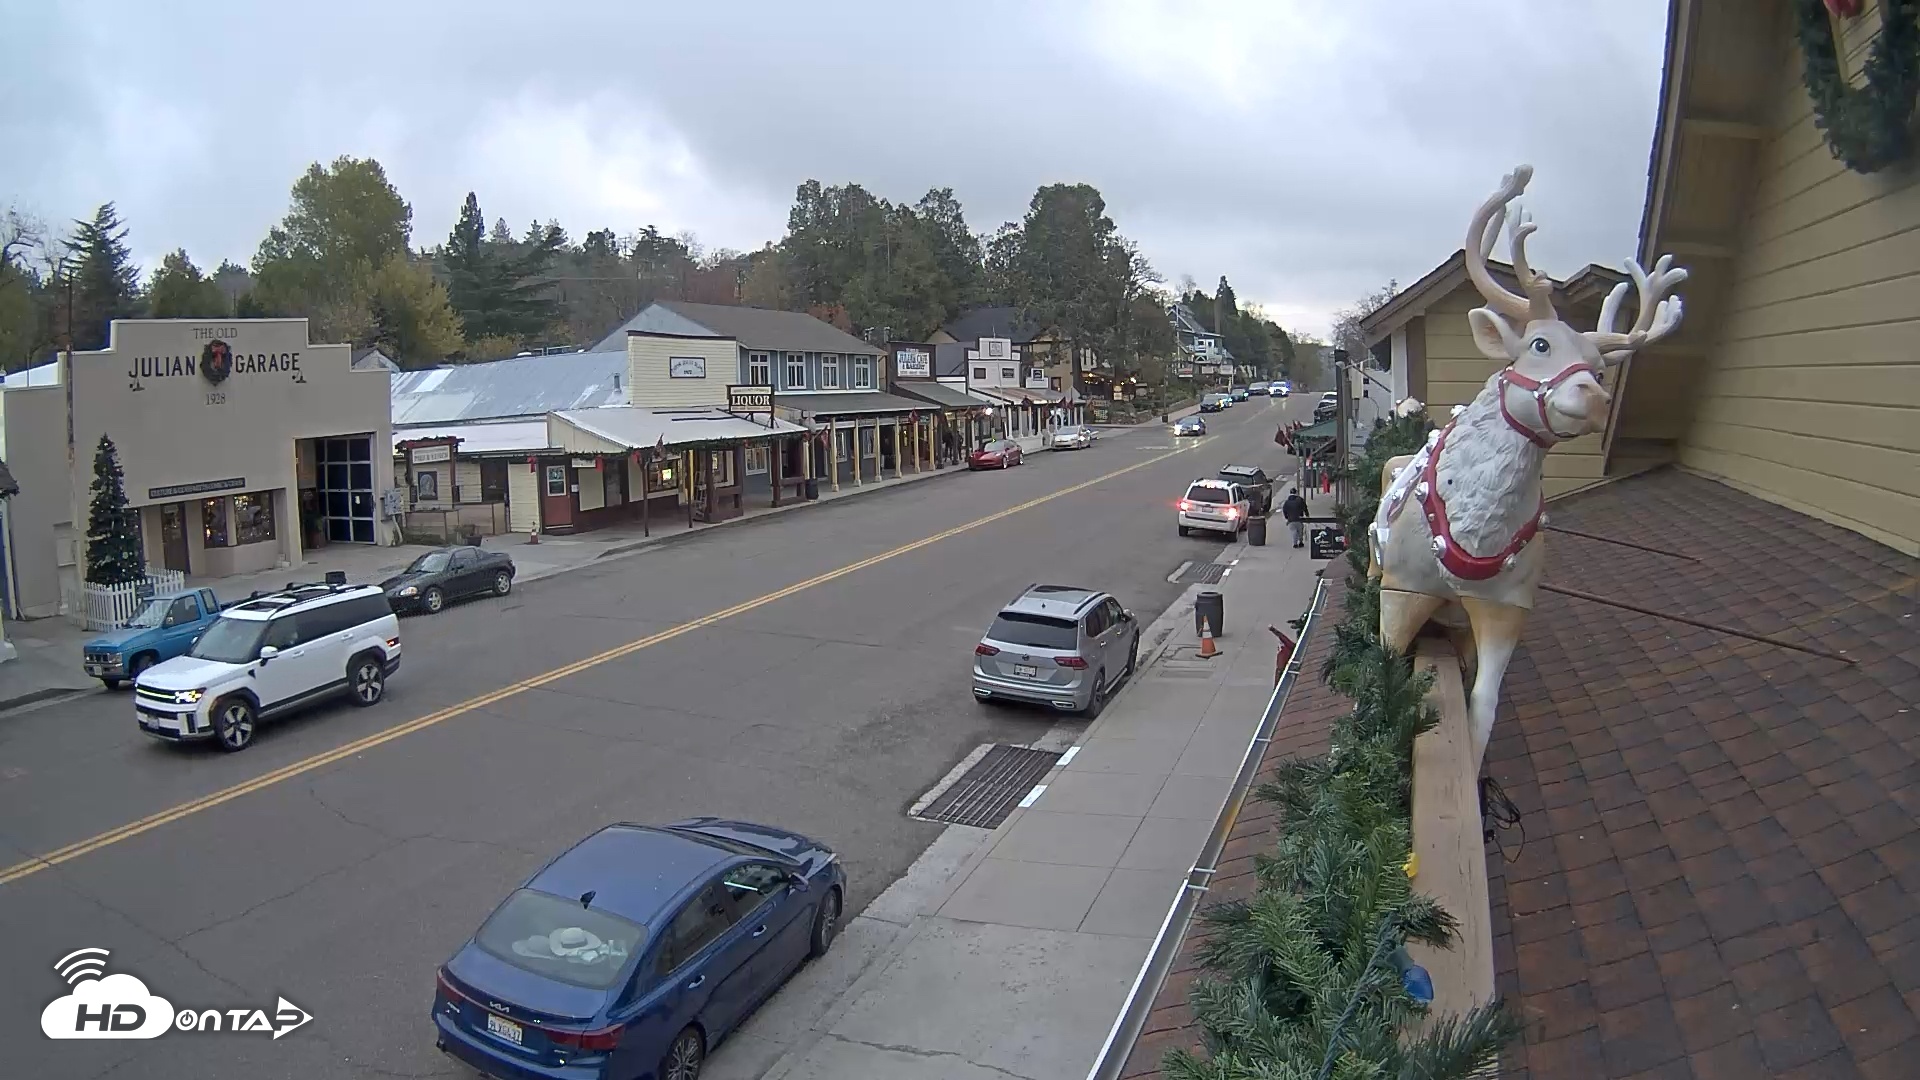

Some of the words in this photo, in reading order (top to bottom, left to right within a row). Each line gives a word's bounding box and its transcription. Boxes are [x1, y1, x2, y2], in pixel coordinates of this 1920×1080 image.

[193, 328, 213, 339] THE
[216, 327, 238, 338] OLD
[129, 355, 196, 378] JULIAN
[235, 353, 301, 374] GARAGE
[206, 393, 226, 406] 1928
[732, 395, 770, 405] LIQUOR
